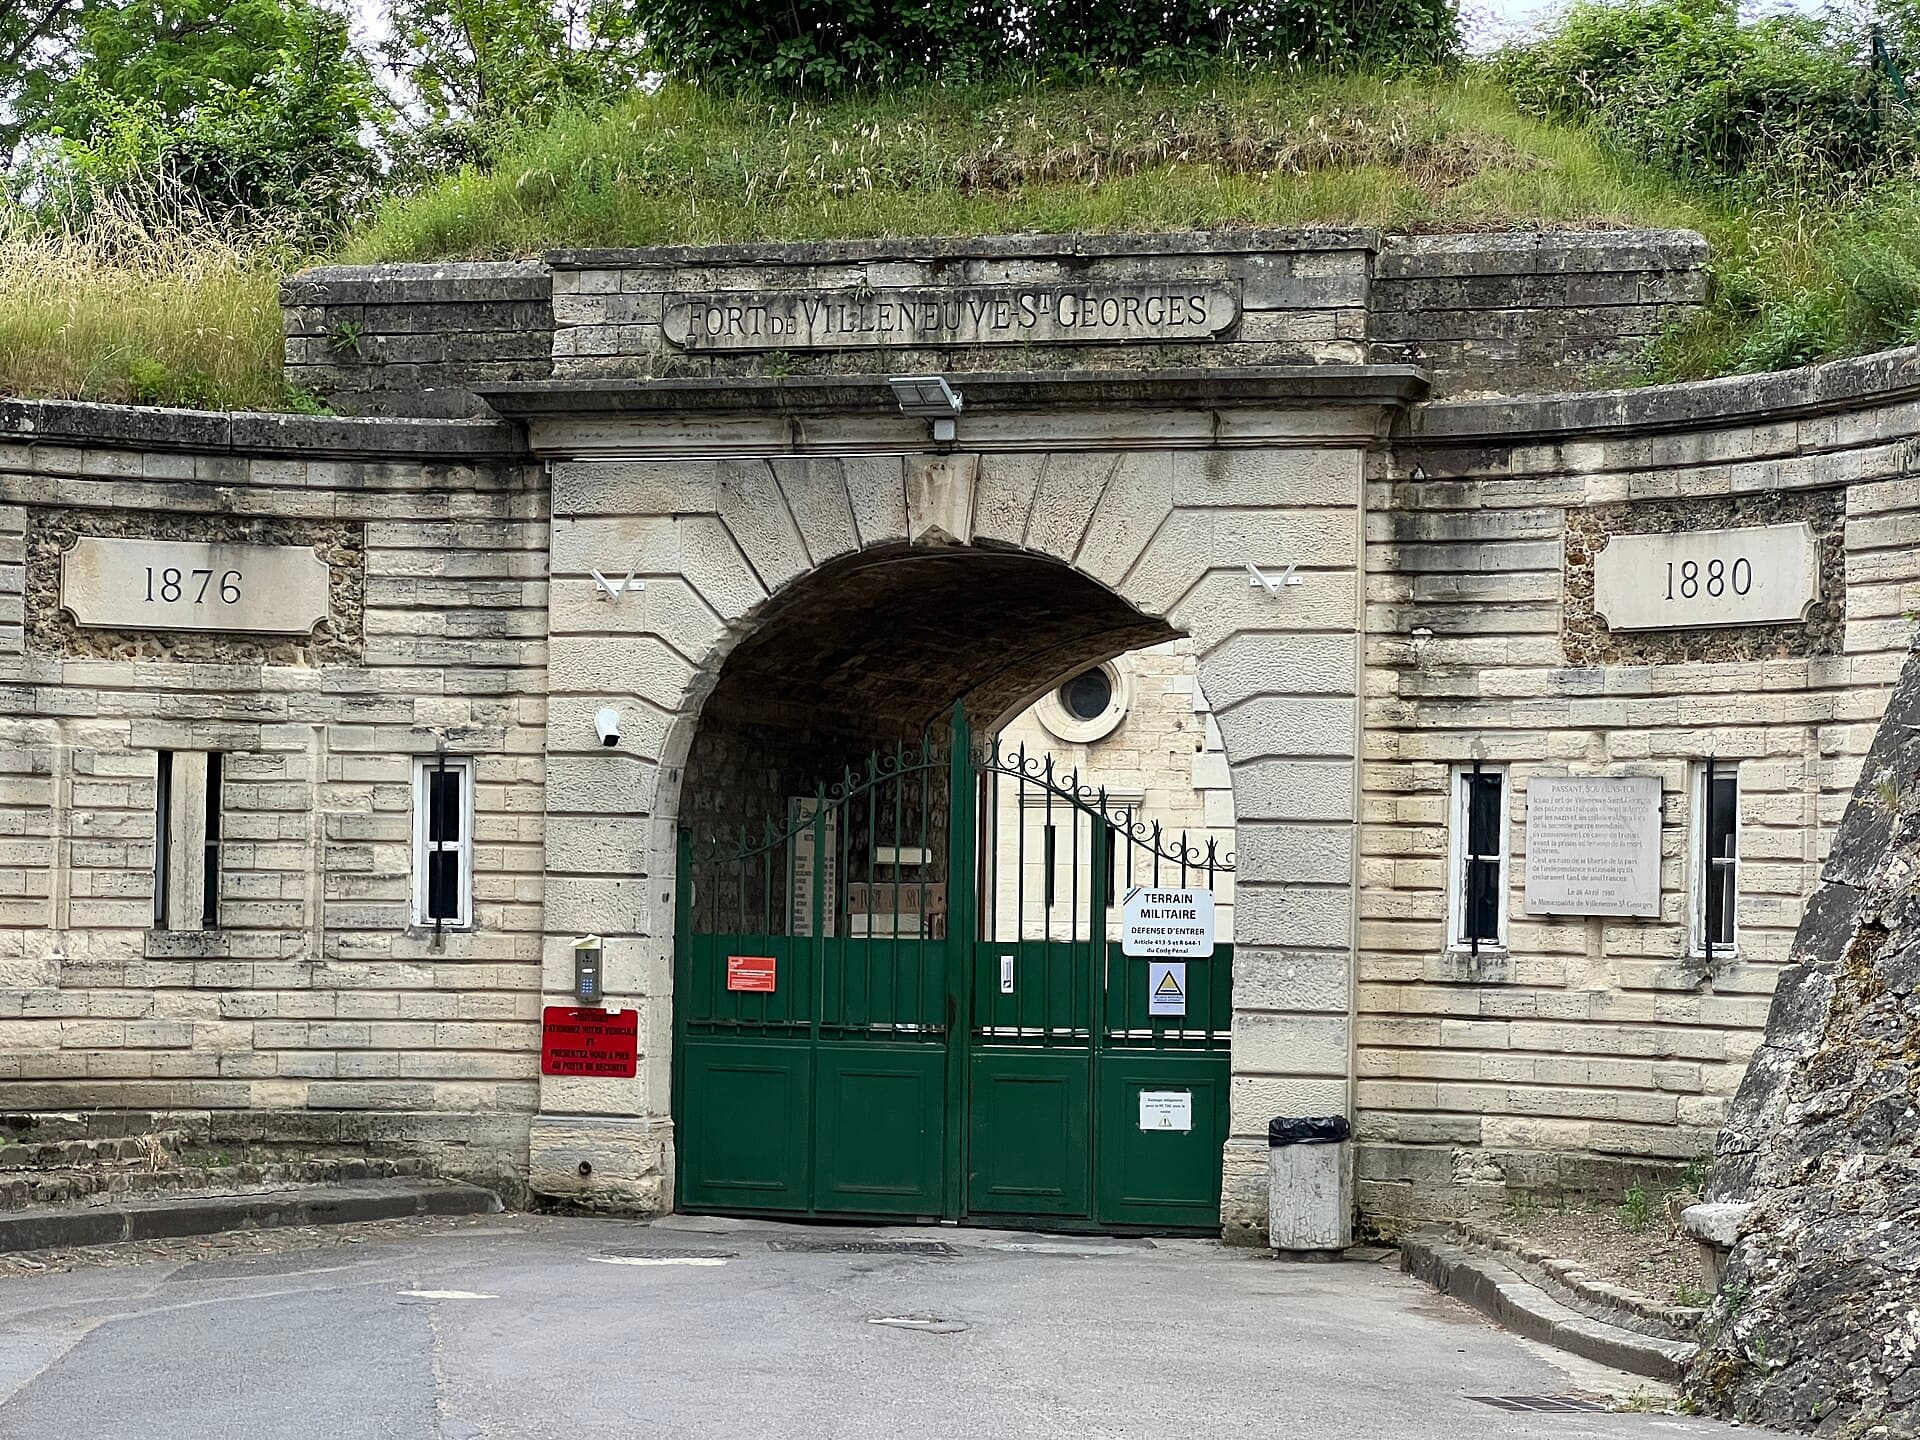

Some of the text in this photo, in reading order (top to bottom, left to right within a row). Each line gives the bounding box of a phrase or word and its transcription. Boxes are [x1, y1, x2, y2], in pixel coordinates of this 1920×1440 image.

[688, 301, 767, 336] FORT
[771, 316, 797, 335] DE
[1057, 293, 1207, 328] GEORGES
[145, 567, 242, 604] 1876
[1664, 558, 1751, 600] 1880
[1144, 894, 1193, 904] TERRAIN
[1140, 909, 1196, 920] MILITAIRE
[1167, 928, 1205, 936] D'ENTRER
